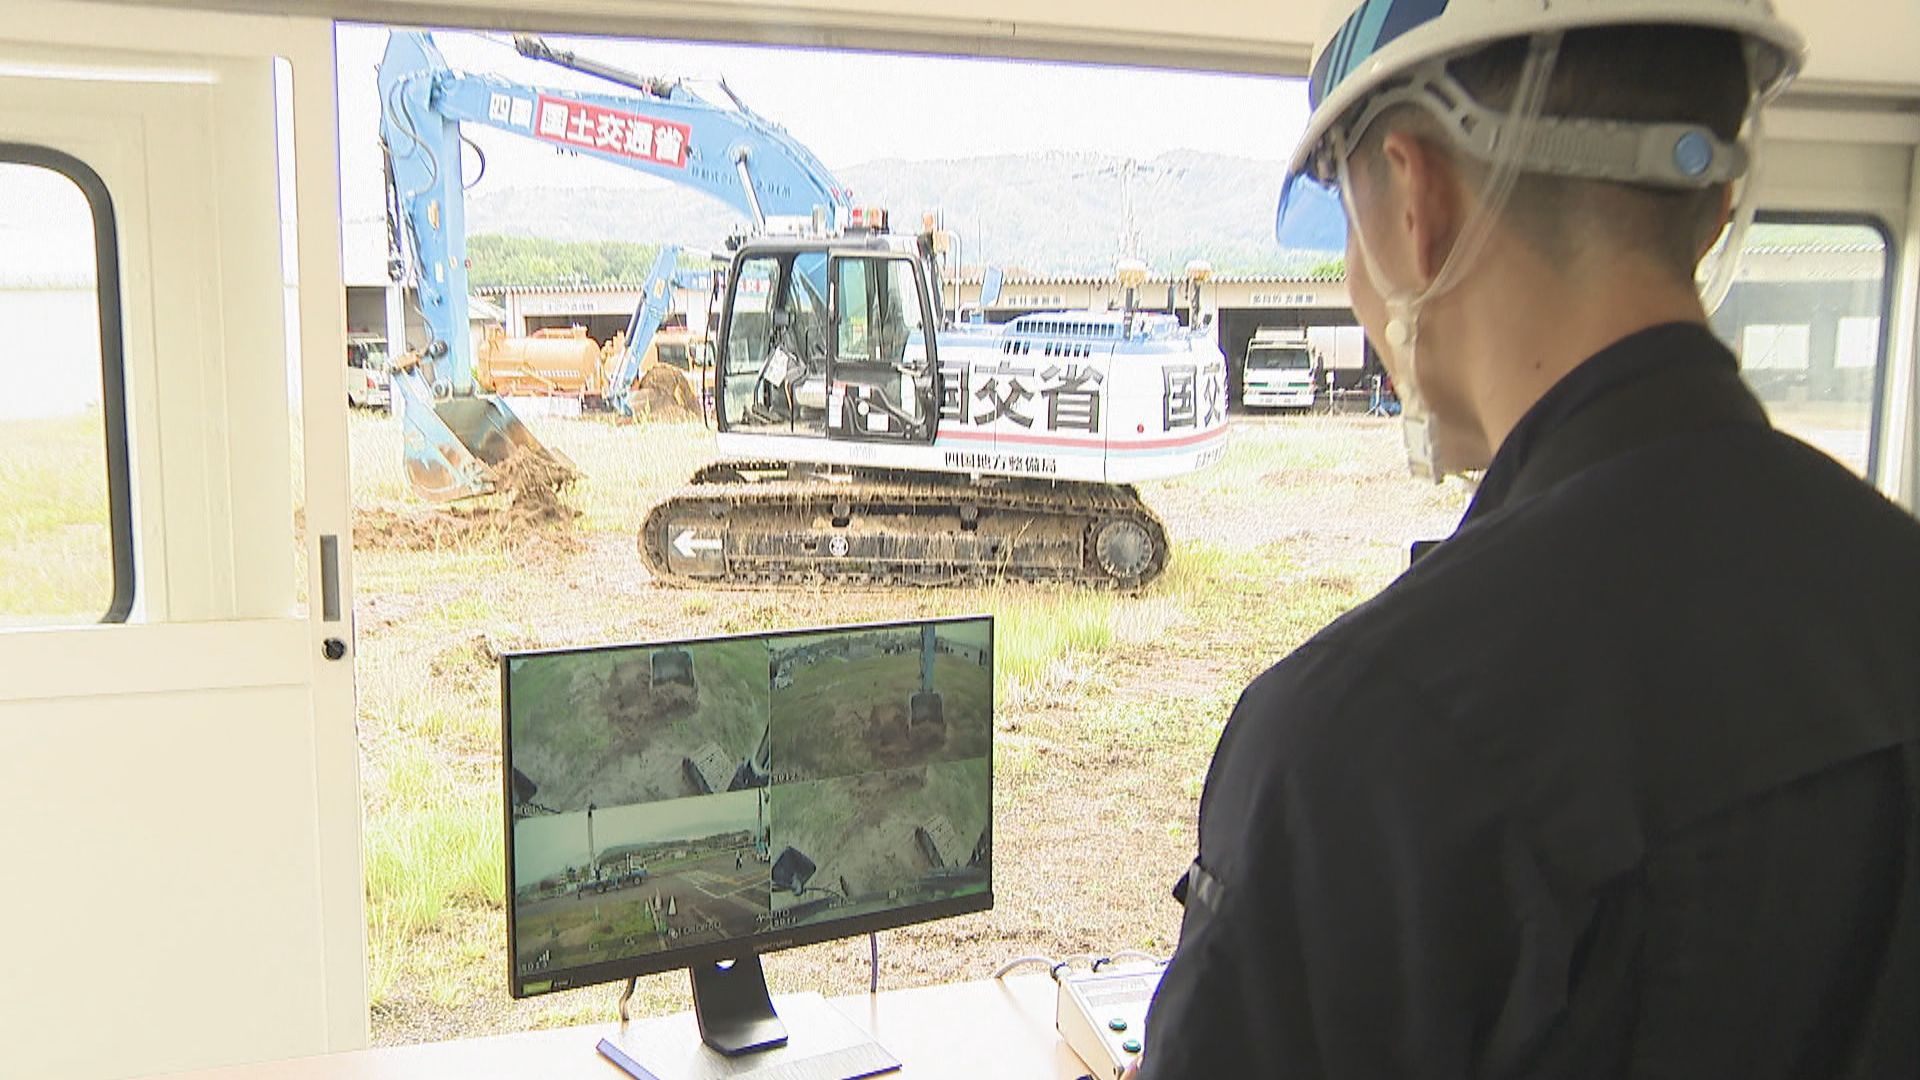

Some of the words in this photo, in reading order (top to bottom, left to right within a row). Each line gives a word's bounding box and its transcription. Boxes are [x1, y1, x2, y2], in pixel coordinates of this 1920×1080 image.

[540, 101, 684, 164] 国土交通省
[945, 451, 1057, 474] 四国地方整備局
